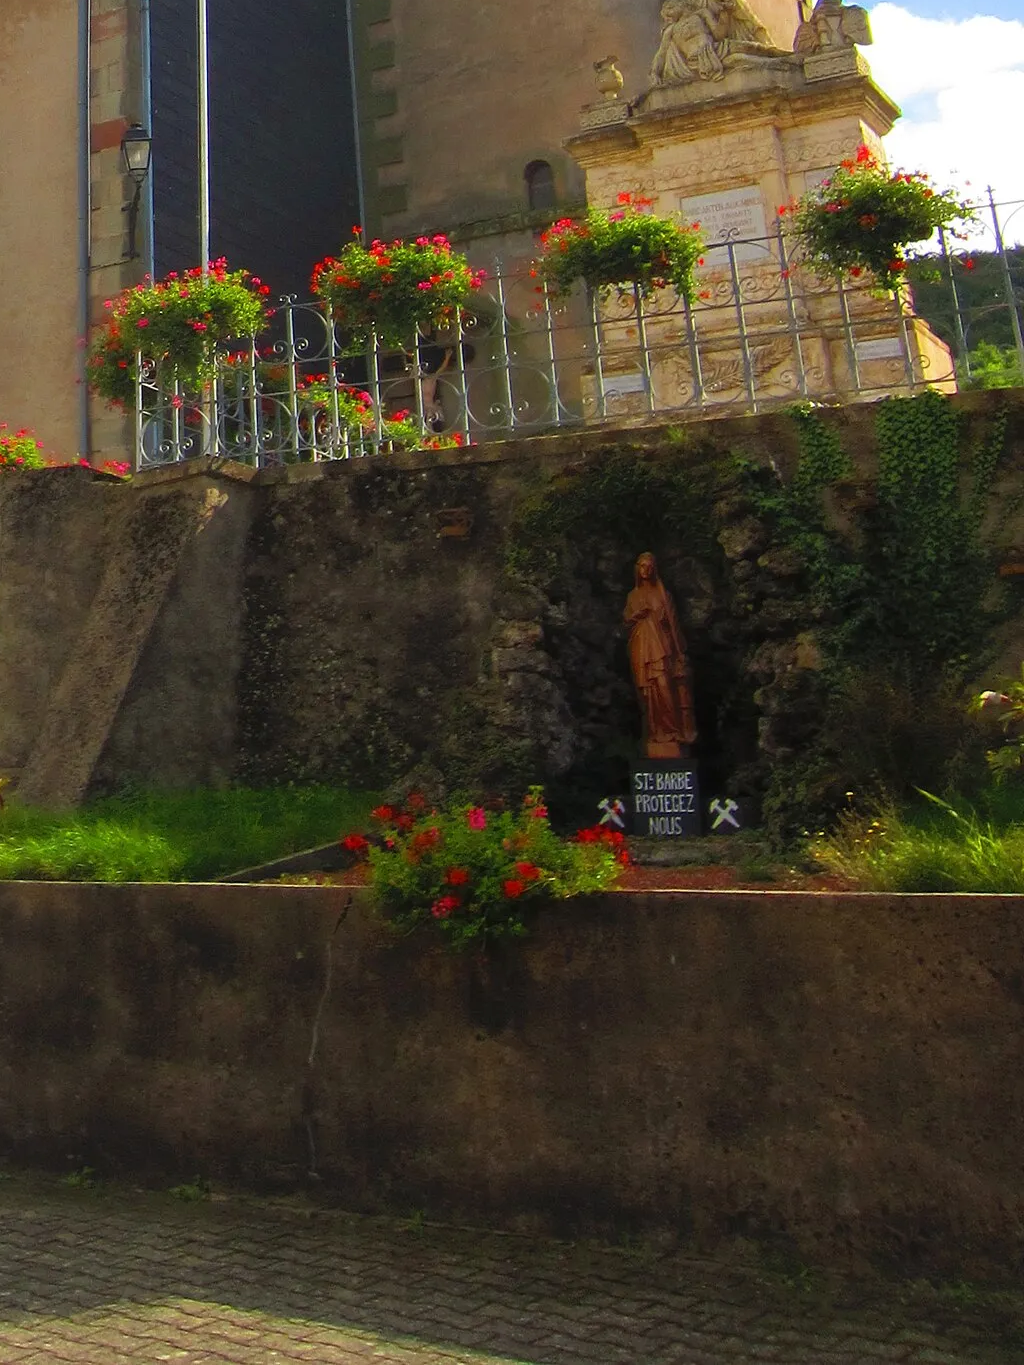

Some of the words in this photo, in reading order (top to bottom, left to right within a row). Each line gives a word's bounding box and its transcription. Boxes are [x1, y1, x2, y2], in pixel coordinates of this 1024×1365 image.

[656, 771, 693, 790] BARBE
[635, 794, 695, 812] PROTEGEZ
[649, 816, 682, 835] NOUS
